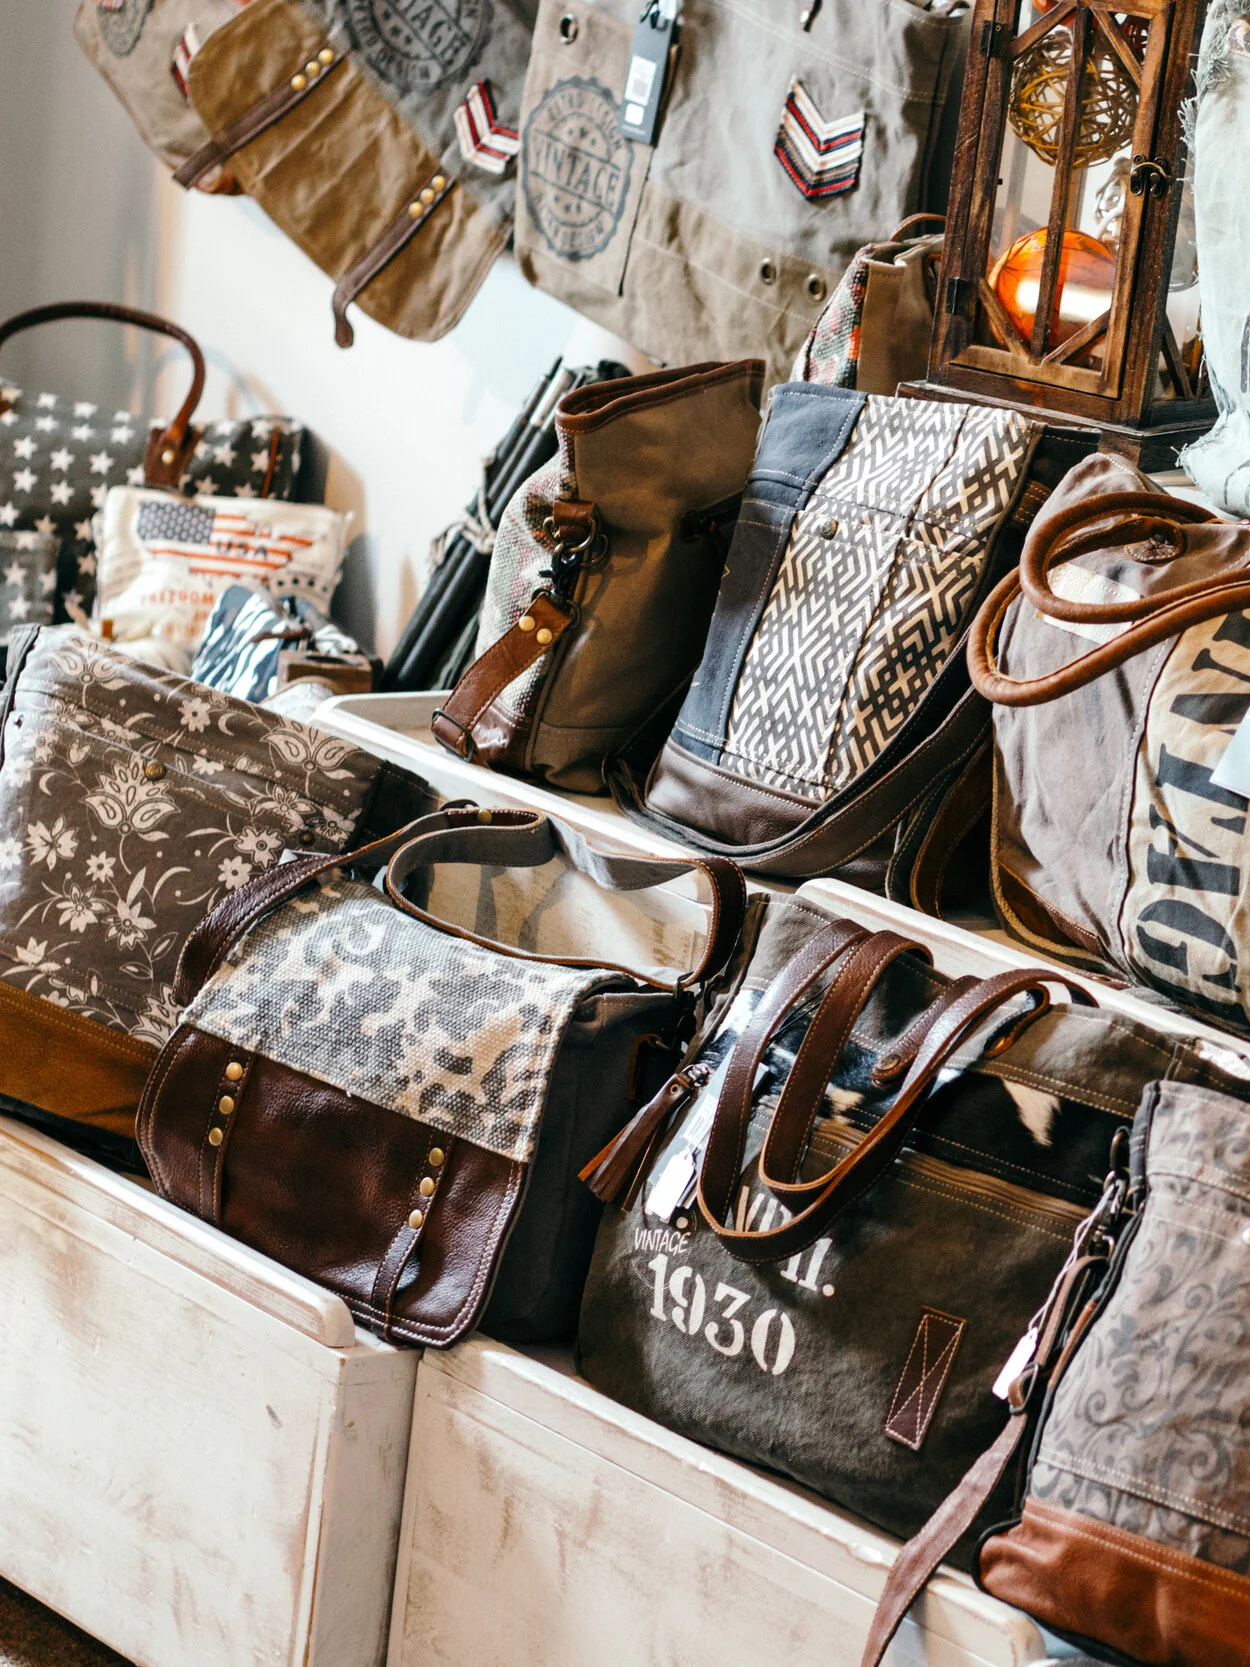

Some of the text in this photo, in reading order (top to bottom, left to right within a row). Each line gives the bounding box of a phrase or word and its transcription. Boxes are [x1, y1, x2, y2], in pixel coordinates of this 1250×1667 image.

[533, 135, 620, 208] VINTAGE
[216, 540, 268, 559] USA
[634, 1228, 691, 1256] VINTAGE
[648, 1253, 796, 1376] 1930
